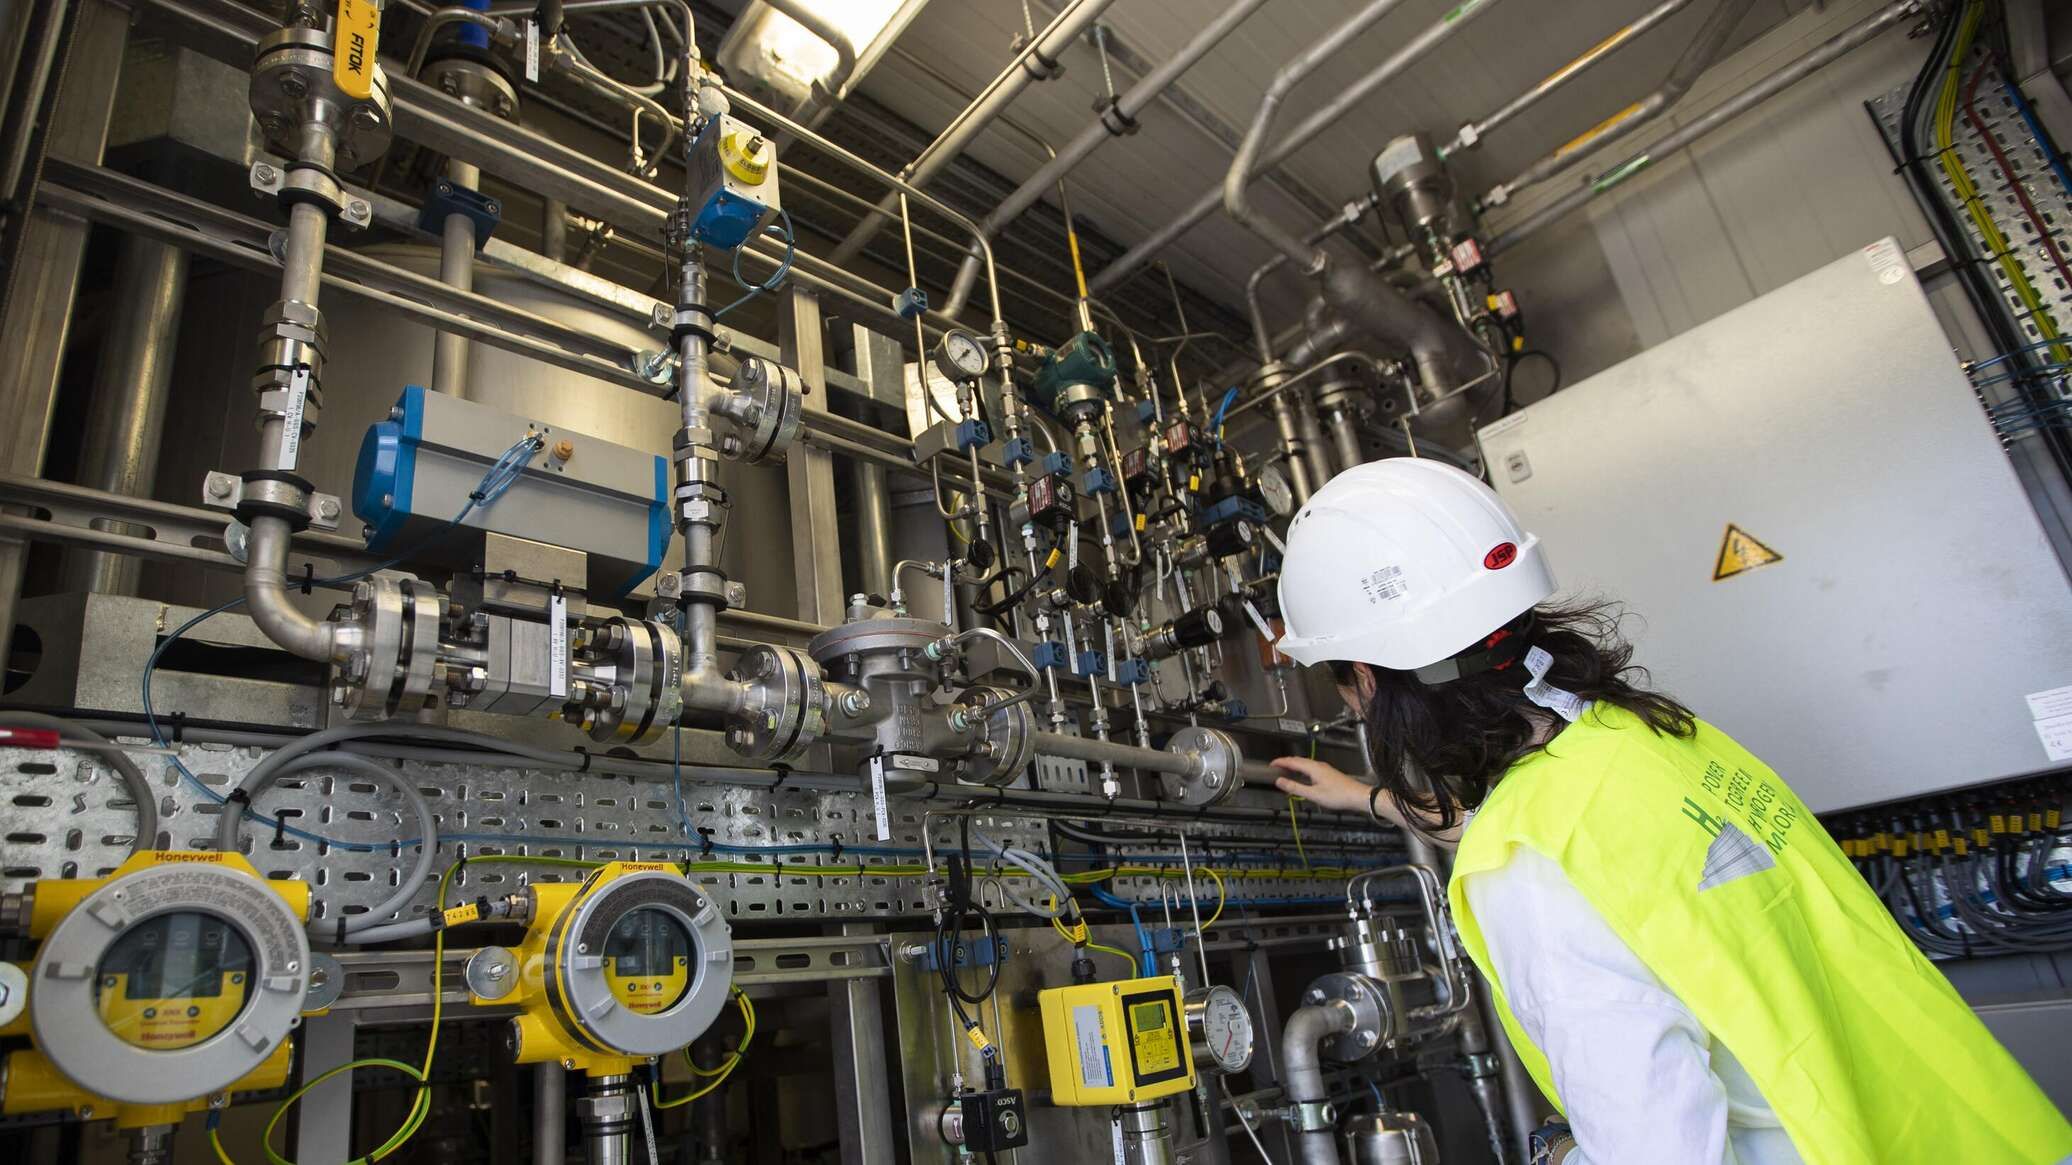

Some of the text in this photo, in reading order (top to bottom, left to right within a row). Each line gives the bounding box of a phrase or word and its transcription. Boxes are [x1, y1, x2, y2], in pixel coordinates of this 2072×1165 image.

[348, 32, 365, 76] FITOK
[1491, 545, 1514, 567] JSP
[155, 852, 224, 863] Honeywell
[622, 863, 664, 871] Honeywell
[996, 1096, 1017, 1107] ASCO
